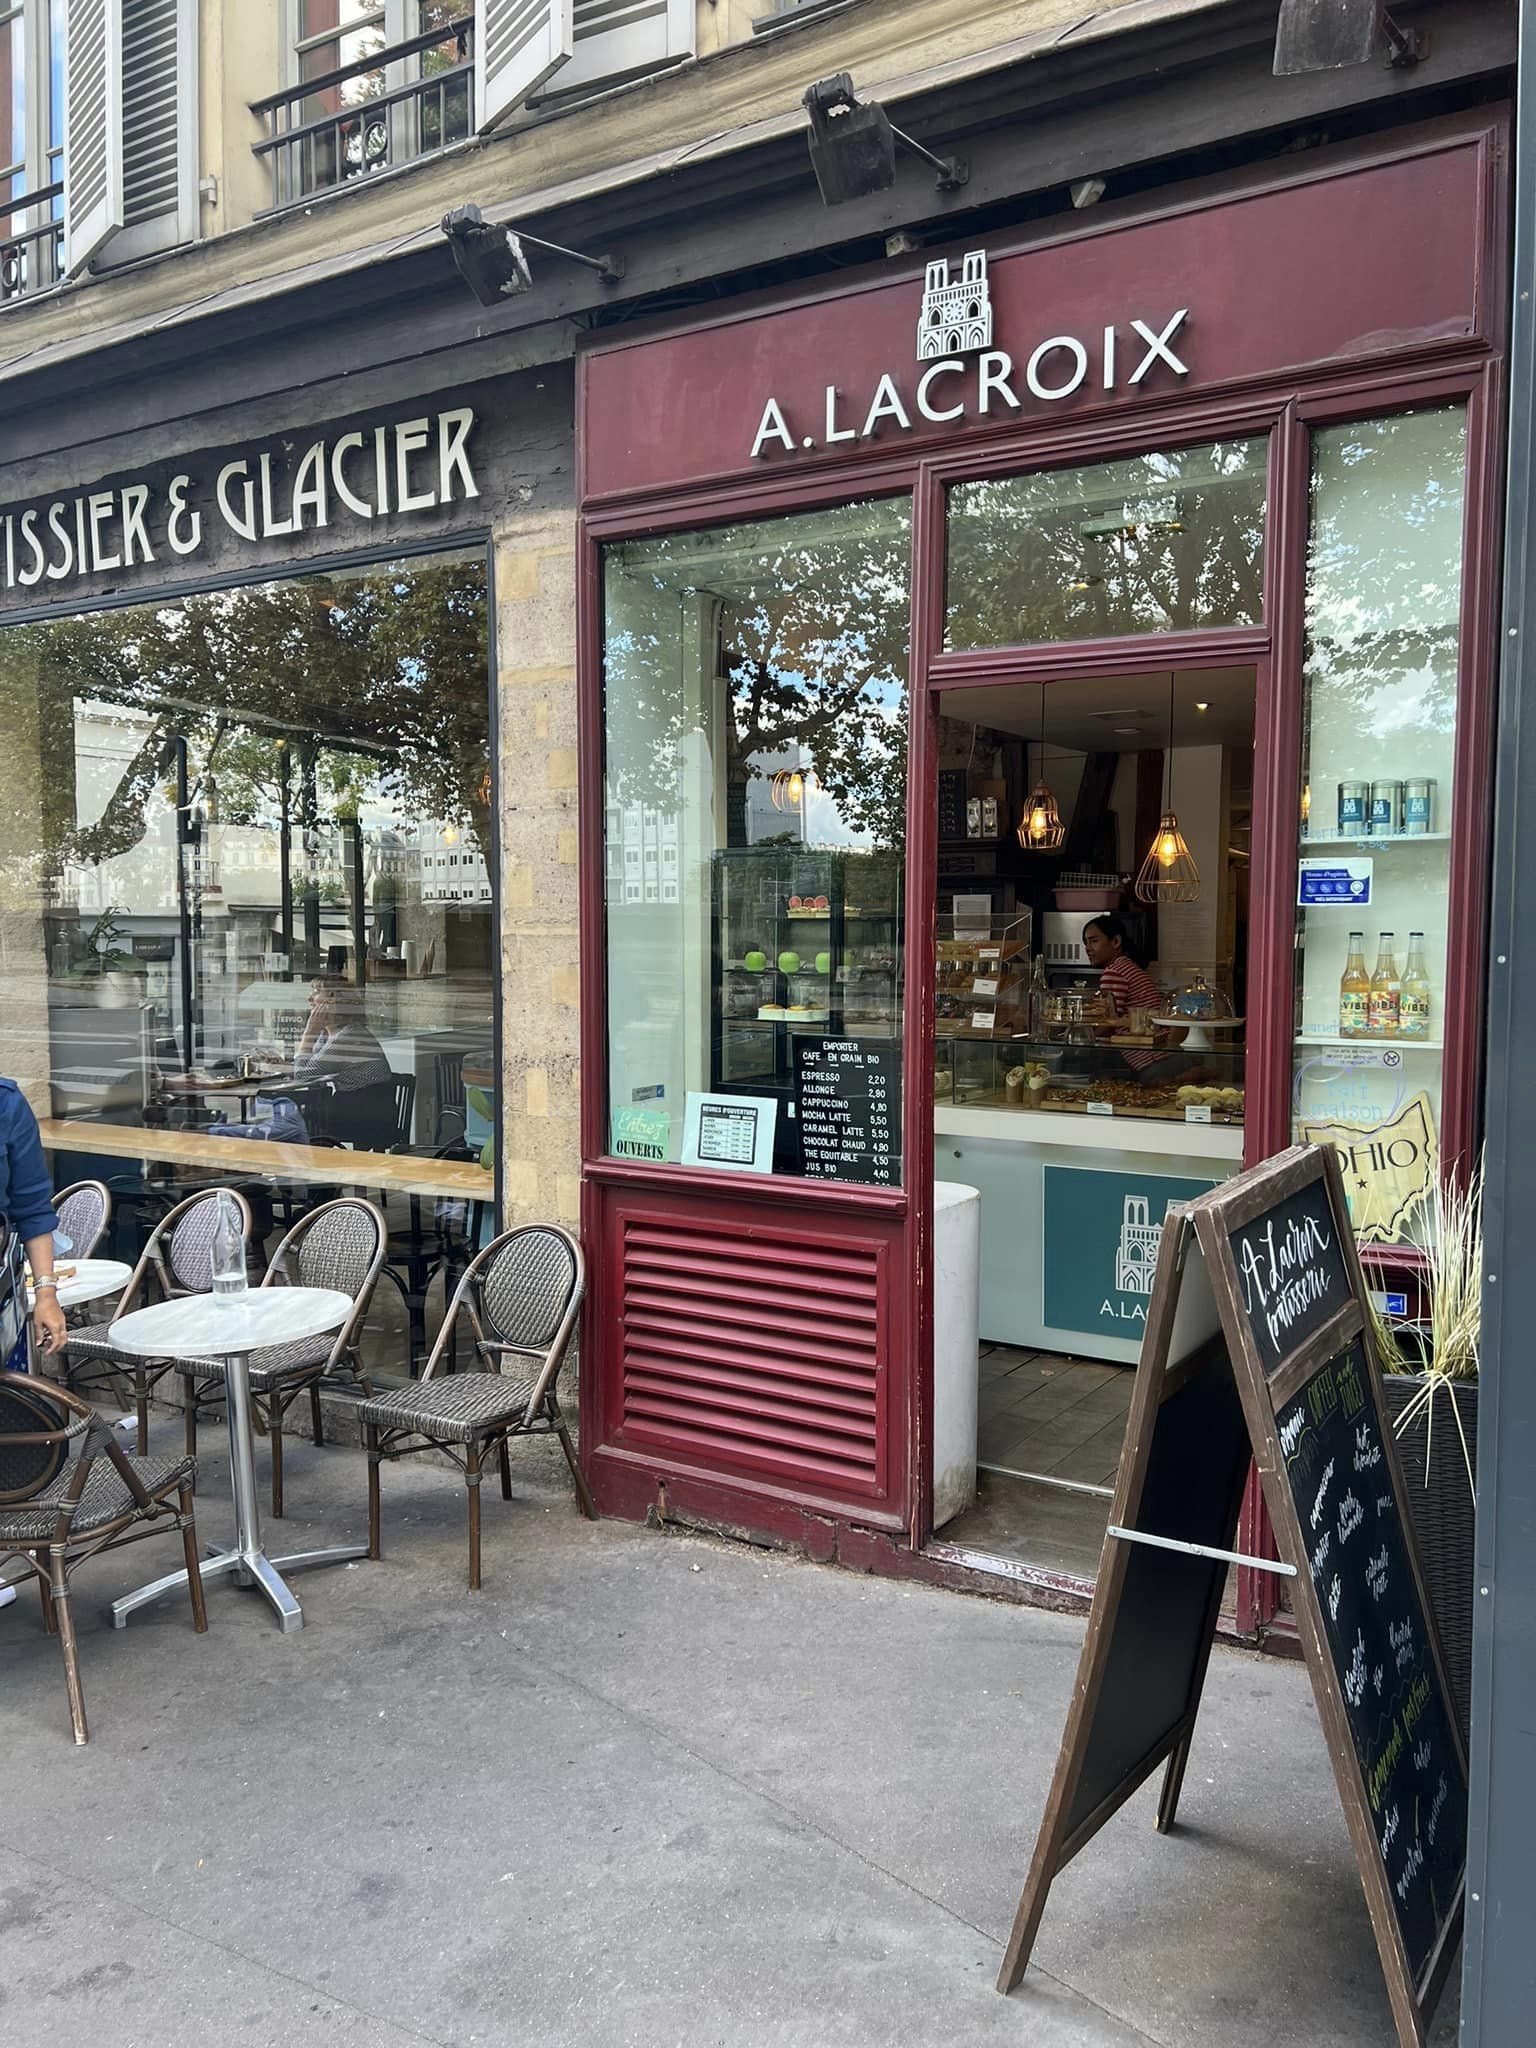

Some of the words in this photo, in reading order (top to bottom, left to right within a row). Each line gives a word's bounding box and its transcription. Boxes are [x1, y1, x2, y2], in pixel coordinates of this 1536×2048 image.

[0, 484, 154, 588] ISSIER
[168, 474, 201, 555] &
[216, 407, 481, 541] GLACIER
[823, 1041, 859, 1051] EMPORTER
[802, 1052, 821, 1061] CAFE
[828, 1053, 837, 1062] EN
[867, 1055, 880, 1064] BIO
[801, 1071, 840, 1082] ESPRESSO
[801, 1098, 849, 1109] CAPPUCCINO
[801, 1110, 826, 1120] MOCHA
[829, 1112, 852, 1122] LATTE
[1311, 1102, 1383, 1121] maison
[618, 1111, 665, 1140] Entrez
[803, 1123, 838, 1134] CARAMEL
[842, 1126, 864, 1137] LATTE
[616, 1139, 664, 1159] OUVERTS
[803, 1137, 838, 1148] CHOCOLAT
[841, 1140, 866, 1150] CHAUD
[805, 1149, 818, 1159] THE
[820, 1150, 859, 1162] EQUITABLE
[805, 1162, 821, 1171] JUS
[824, 1163, 837, 1173] BIO
